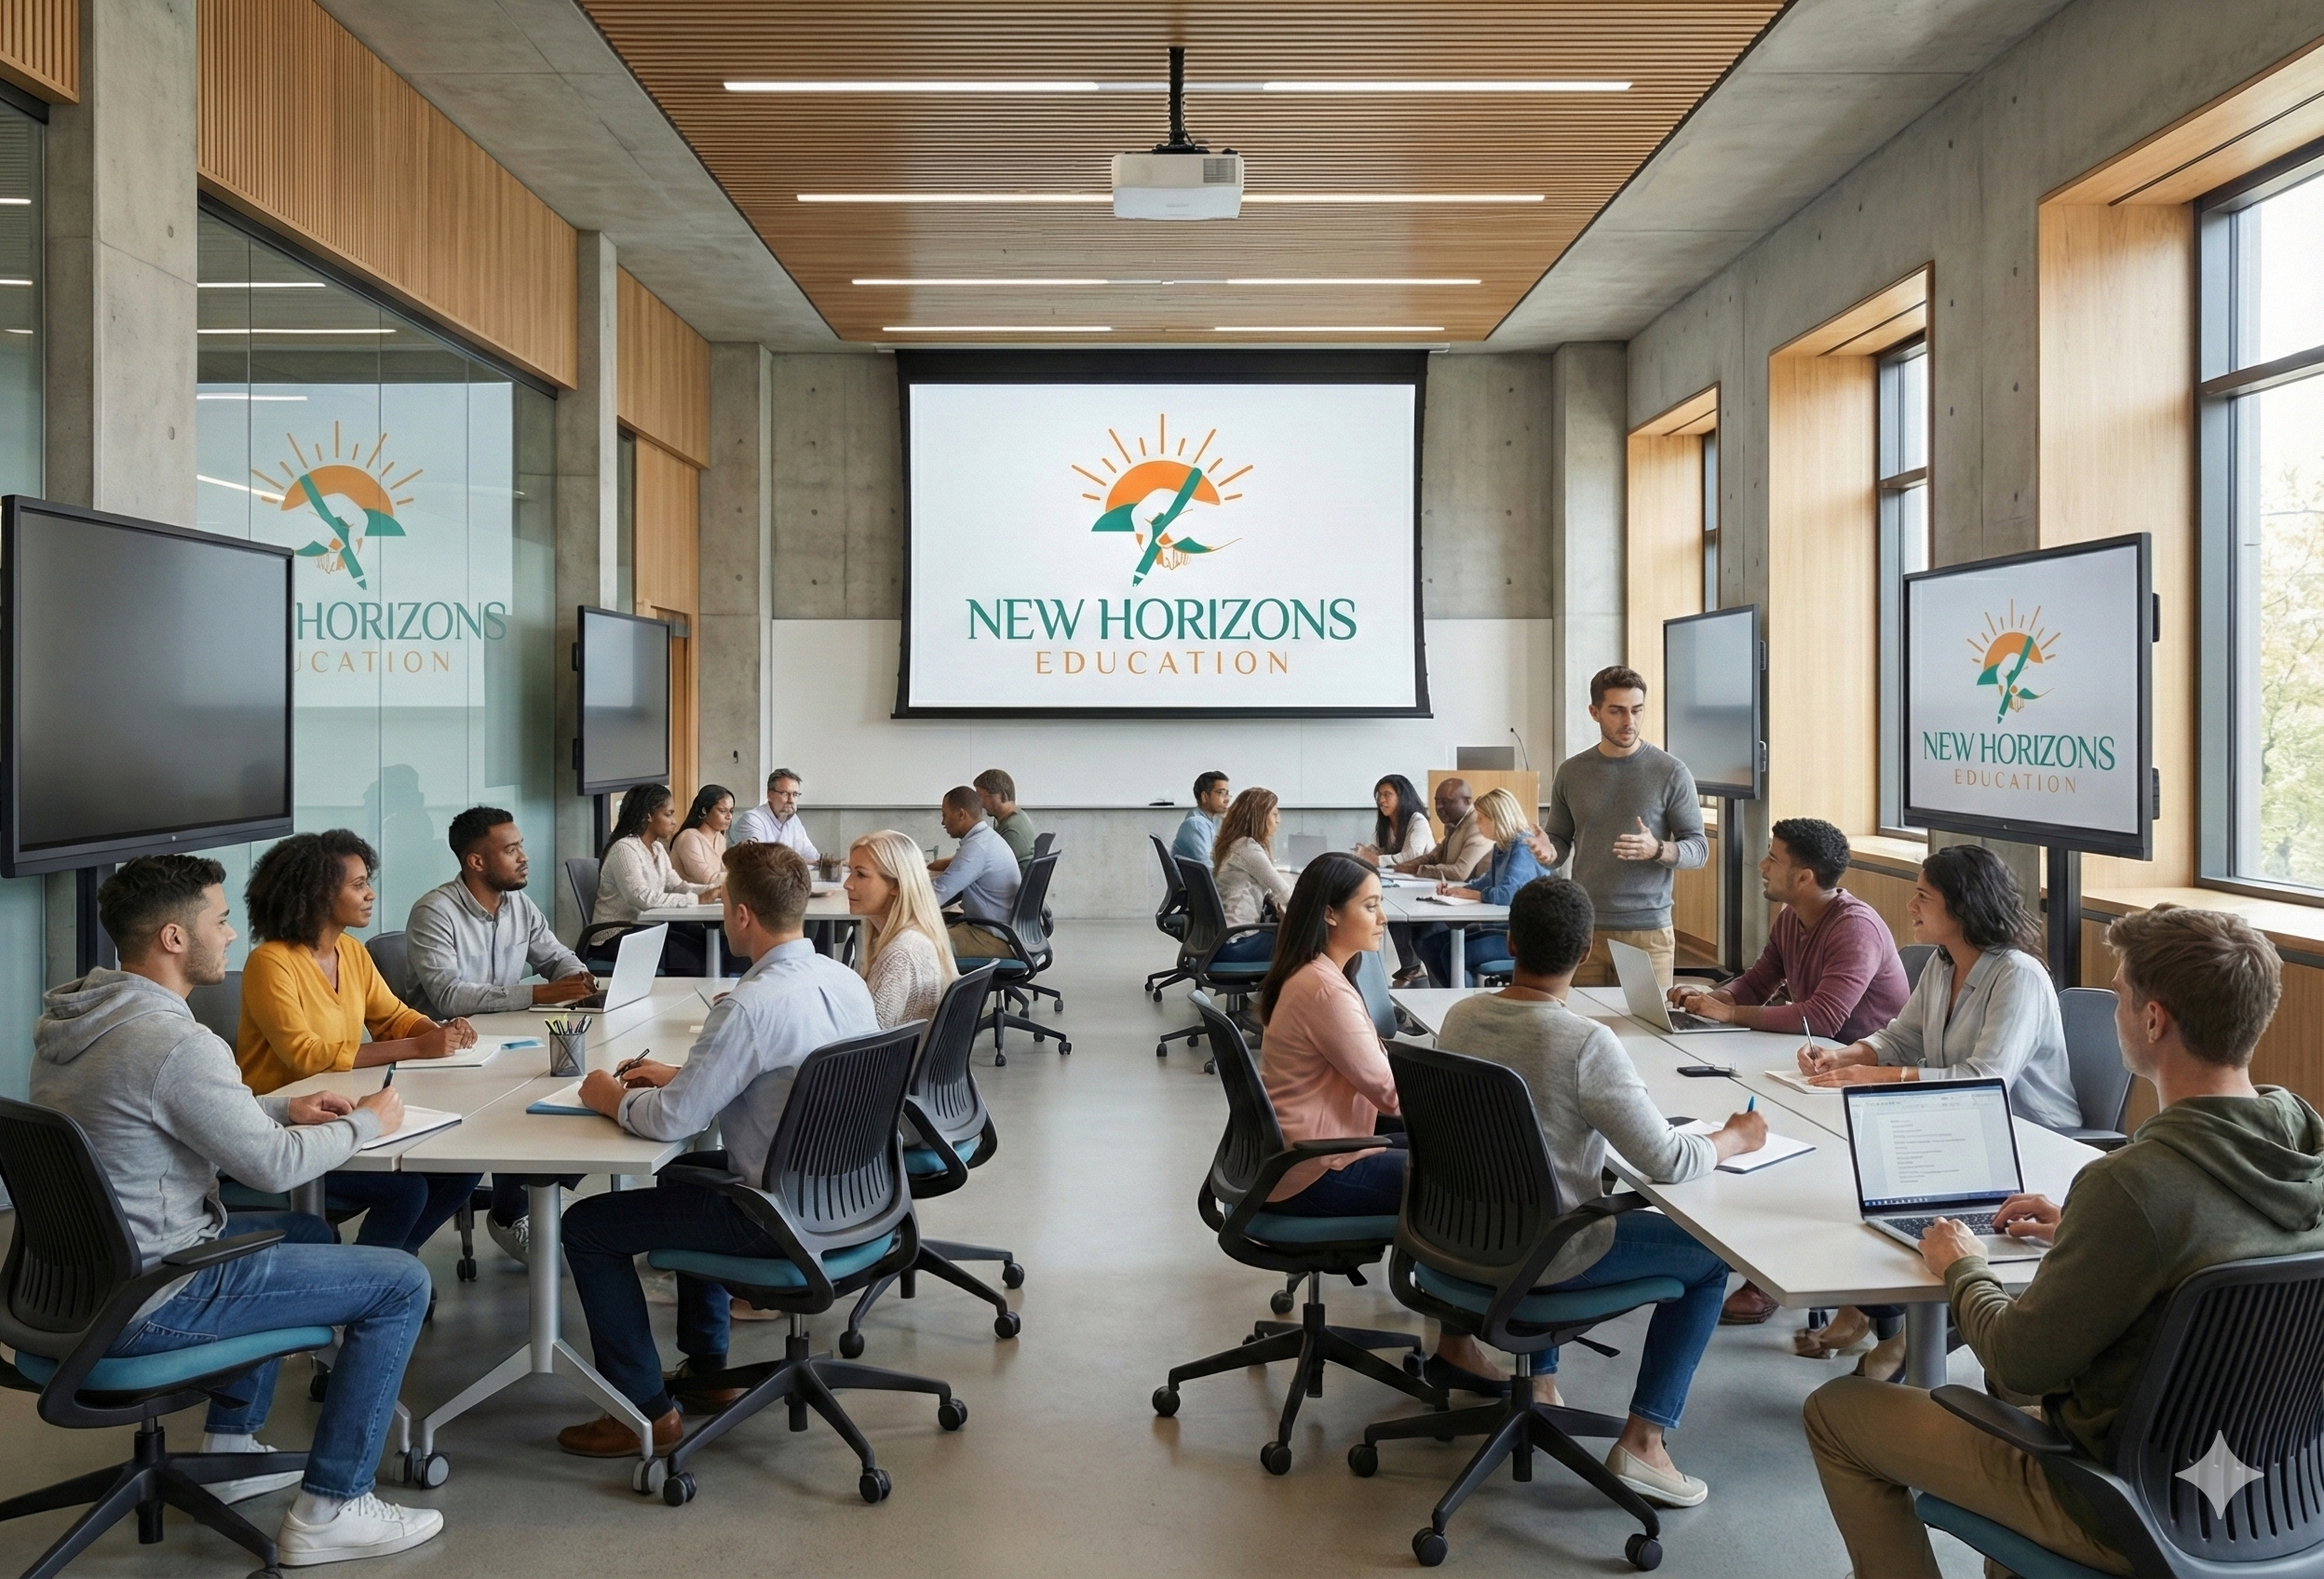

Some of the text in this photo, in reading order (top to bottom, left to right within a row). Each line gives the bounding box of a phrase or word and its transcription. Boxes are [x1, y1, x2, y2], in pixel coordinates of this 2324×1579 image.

[296, 601, 507, 641] HORIZONS
[966, 598, 1358, 641] NEW HORIZONS
[1035, 651, 1289, 675] EDUCATION
[1923, 731, 2115, 771] NEW HORIZONS
[1955, 768, 2076, 793] EDUCATION
